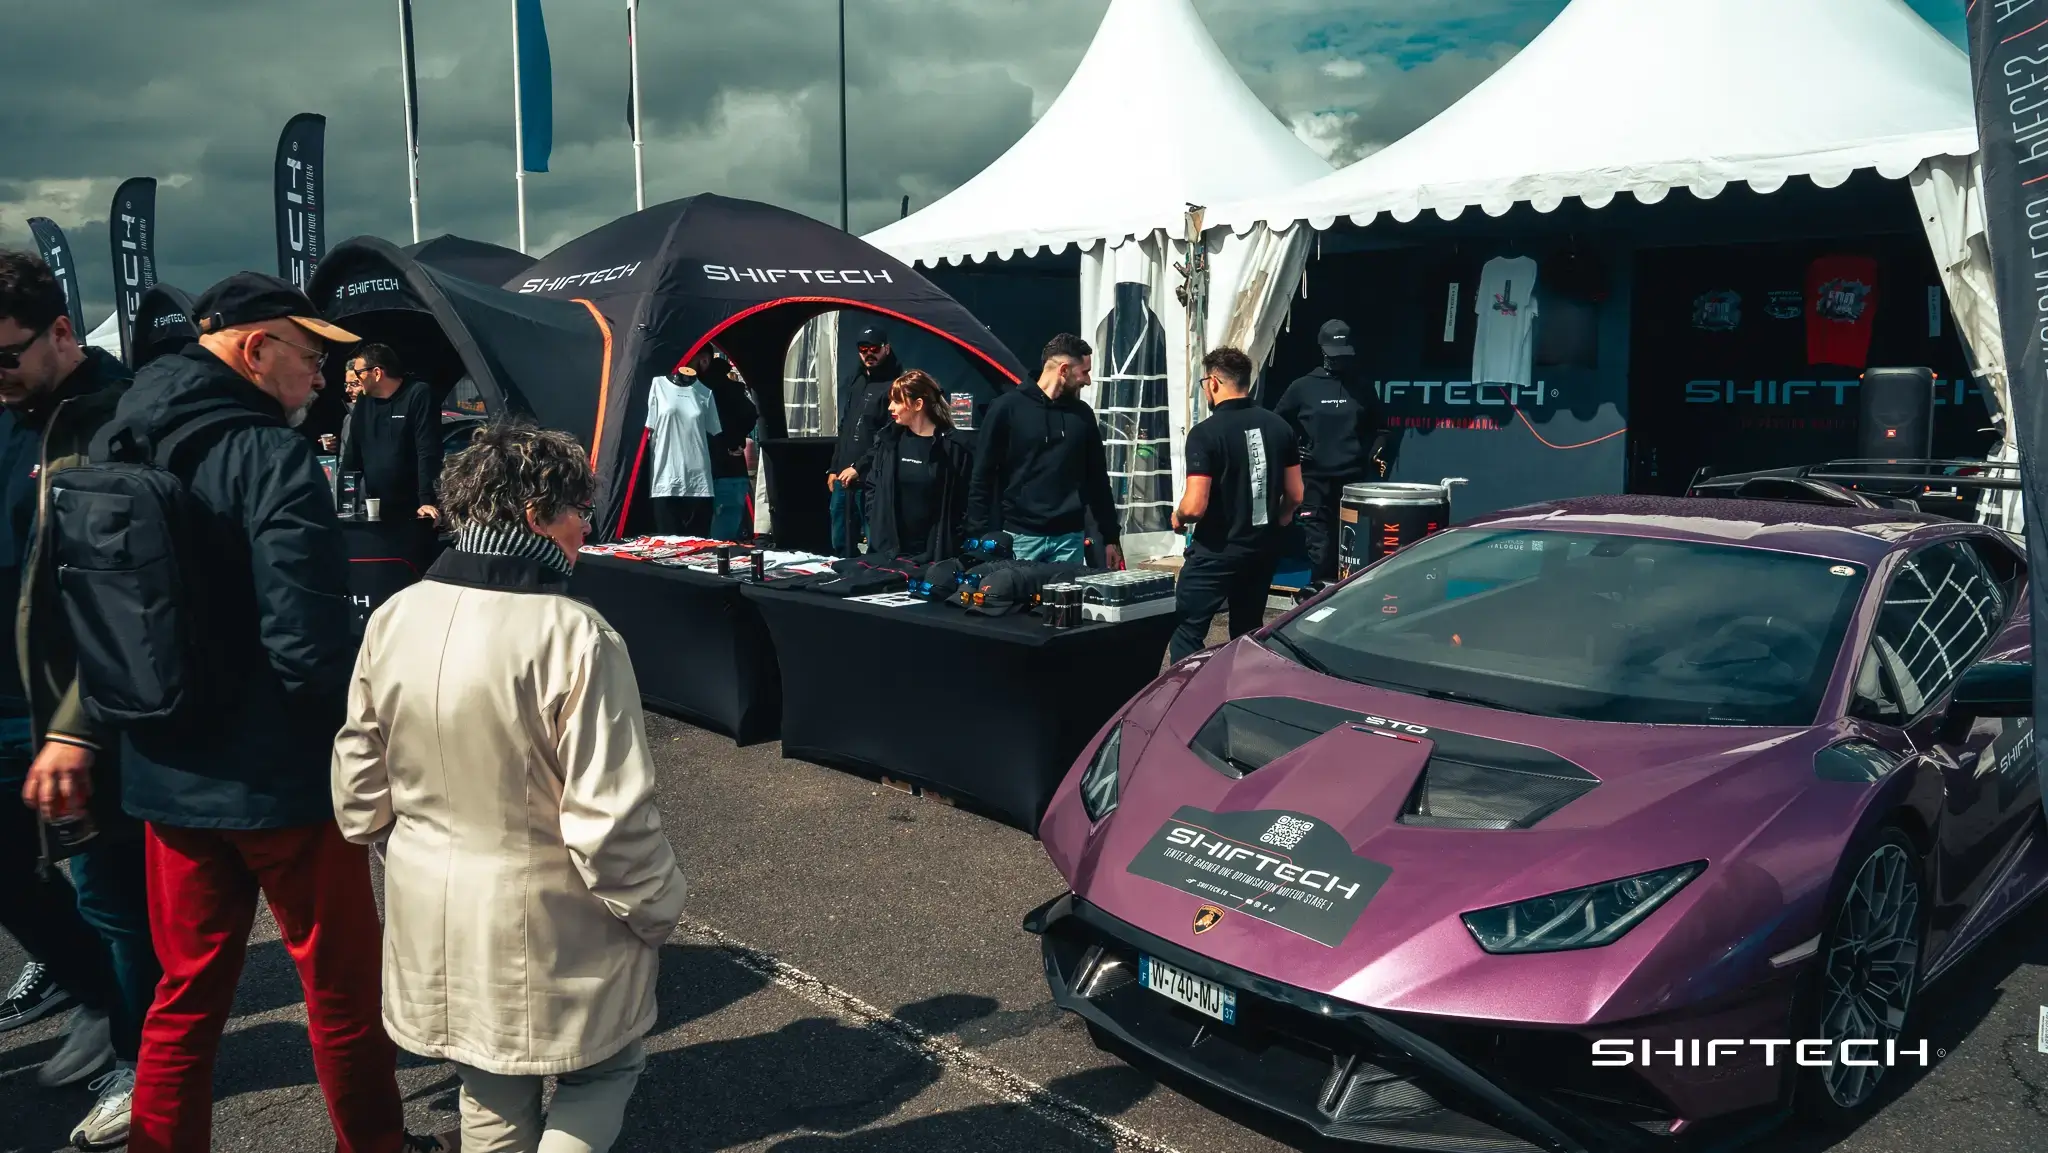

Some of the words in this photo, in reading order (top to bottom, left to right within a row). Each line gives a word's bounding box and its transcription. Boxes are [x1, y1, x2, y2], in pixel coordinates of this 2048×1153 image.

[306, 164, 314, 205] ENTRETIEN
[518, 261, 642, 294] SHIFTECH
[702, 264, 894, 285] SHIFTECH
[347, 278, 400, 296] SHIFTECH
[160, 313, 187, 327] SHIFTECH
[1365, 716, 1429, 735] STO
[1166, 827, 1361, 900] SHIFTECH
[1163, 847, 1188, 862] TENTEZ
[1184, 854, 1197, 865] DE
[1193, 858, 1220, 874] GAGNER
[1217, 866, 1234, 878] UNE
[1231, 871, 1279, 893] OPTIMISATION
[1276, 886, 1305, 901] MOTEUR
[1303, 893, 1328, 910] STAGE
[1141, 972, 1147, 981] F
[1151, 959, 1221, 1014] W-740-MJ
[1224, 1007, 1234, 1020] 37
